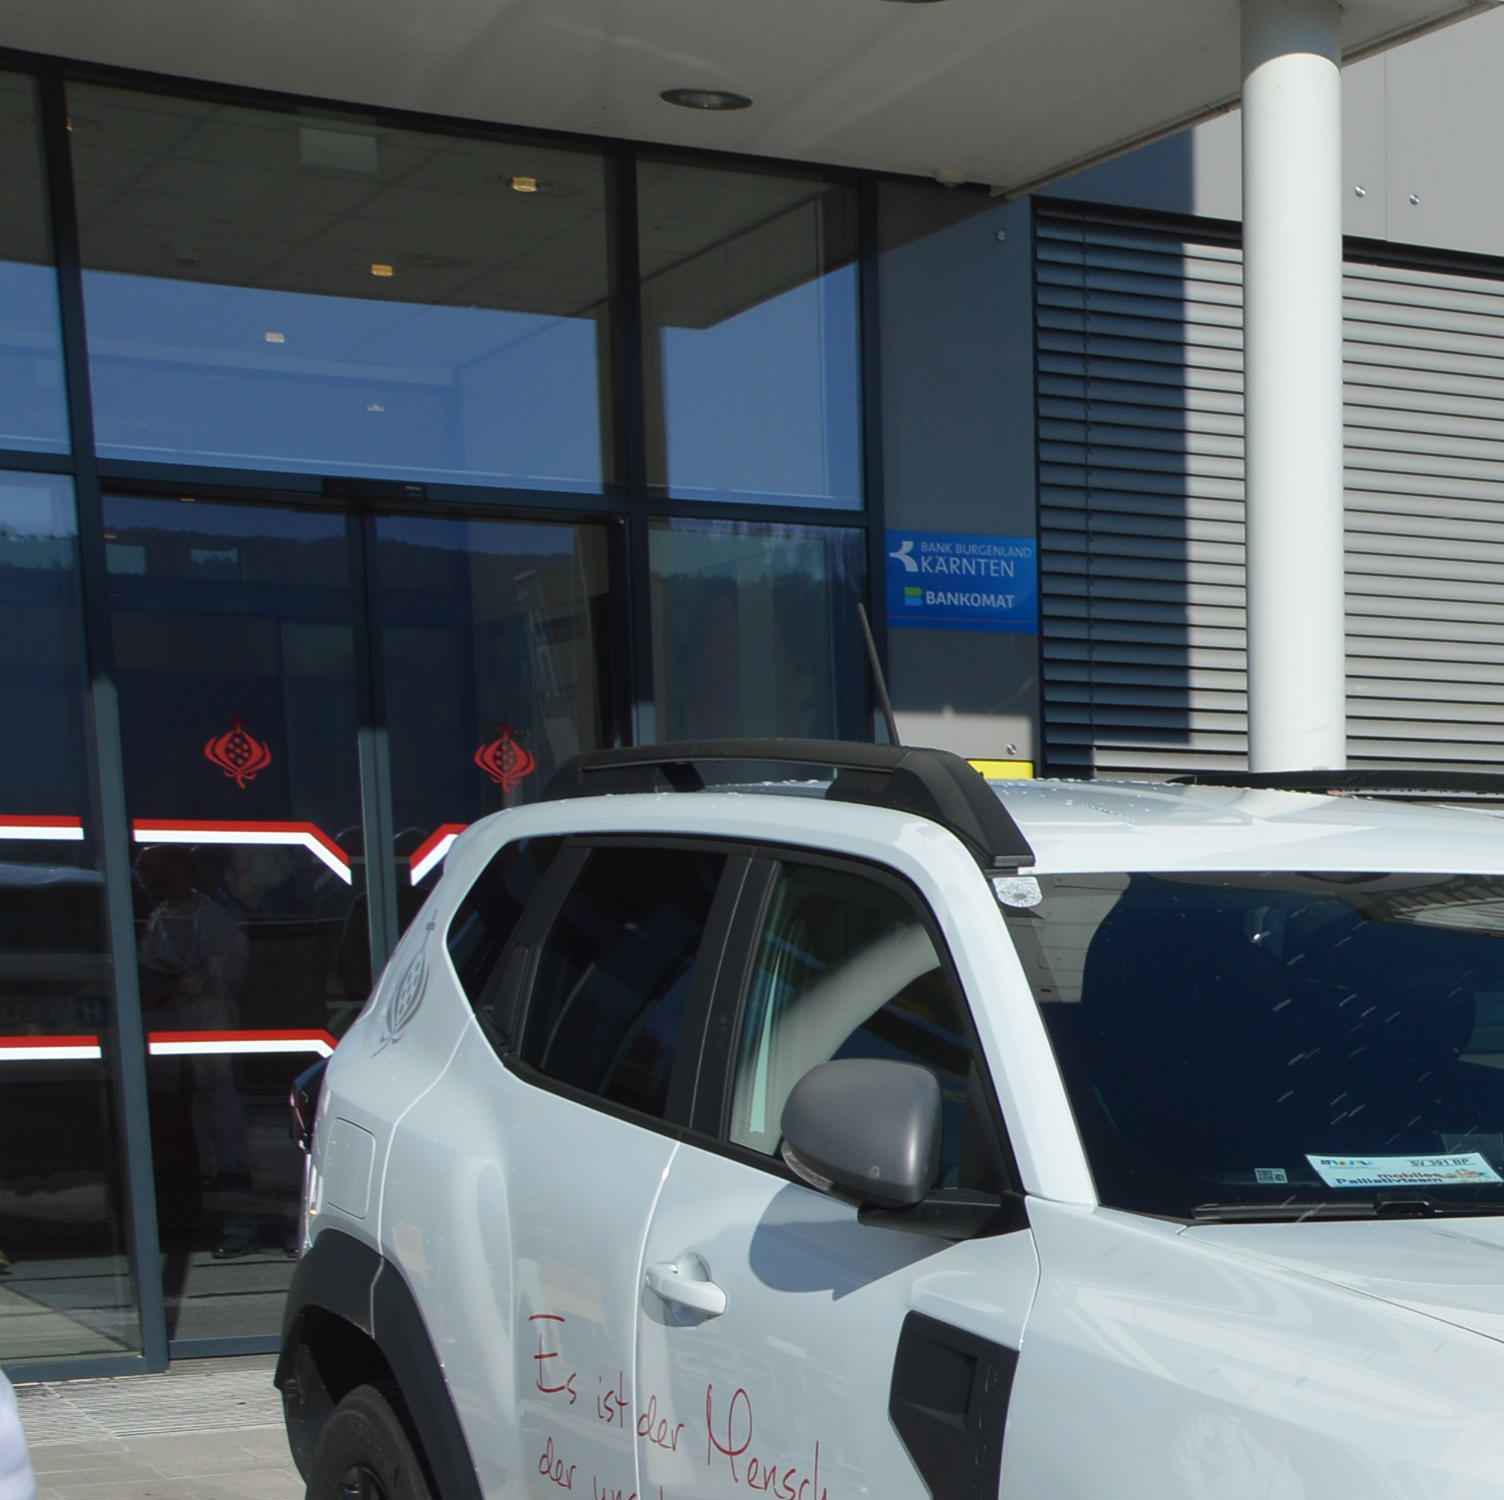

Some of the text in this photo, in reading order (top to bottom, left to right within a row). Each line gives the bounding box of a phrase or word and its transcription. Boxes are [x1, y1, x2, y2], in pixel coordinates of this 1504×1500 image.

[920, 541, 1032, 558] BANK BURGENLAND
[921, 555, 1015, 577] KÄRNTEN
[925, 590, 1015, 608] BANKOMAT
[529, 1314, 577, 1405] Es
[596, 1369, 629, 1428] ist
[636, 1394, 685, 1451] der
[538, 1437, 576, 1489] der
